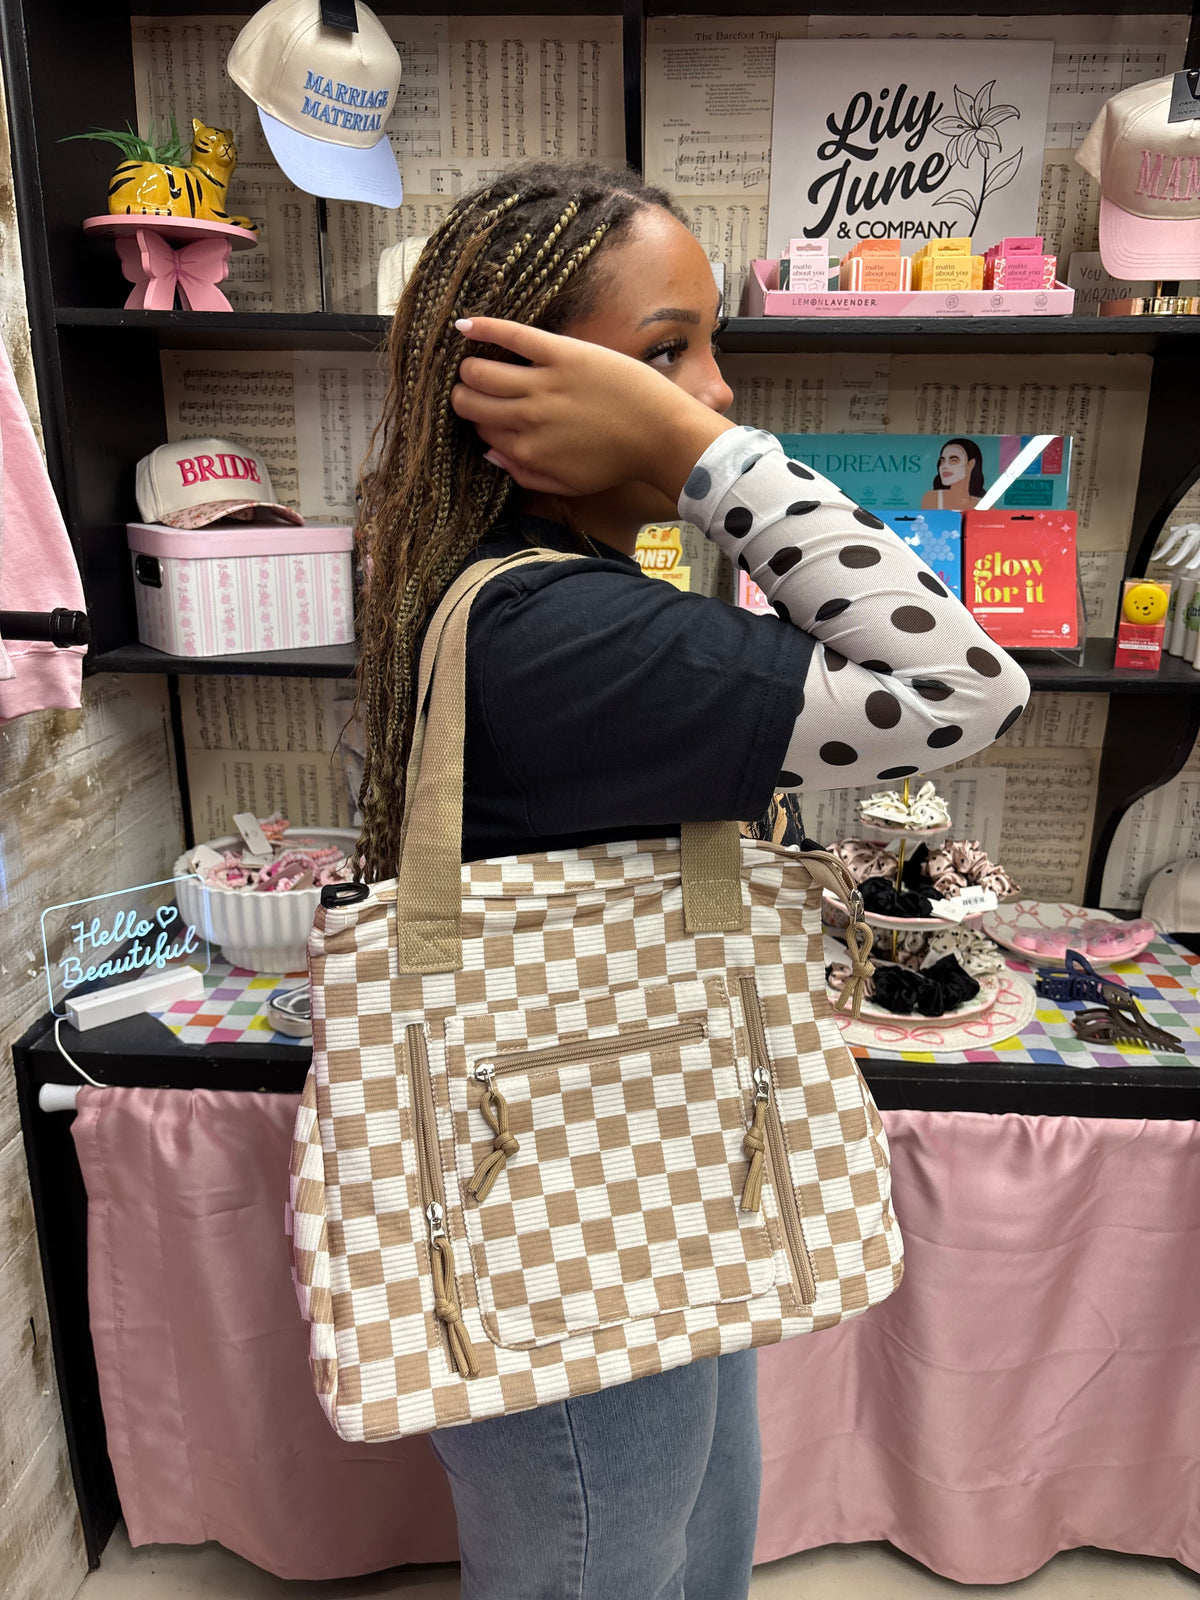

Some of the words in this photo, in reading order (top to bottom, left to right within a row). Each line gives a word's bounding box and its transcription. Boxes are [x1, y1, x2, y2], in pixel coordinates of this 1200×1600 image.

[694, 32, 713, 41] The
[716, 31, 754, 40] Barefoot
[303, 70, 389, 109] MARRIAGE
[301, 96, 382, 132] MATERIAL
[817, 83, 943, 162] Lily
[803, 152, 951, 239] June
[837, 221, 851, 239] &
[856, 221, 957, 239] COMPANY
[812, 270, 825, 278] you
[176, 453, 262, 487] BRIDE
[826, 454, 922, 473] DREAMS
[973, 552, 1048, 587] glow
[975, 582, 1019, 604] for
[1025, 579, 1047, 604] it
[70, 910, 155, 953] Hello
[58, 924, 200, 989] Beautiful
